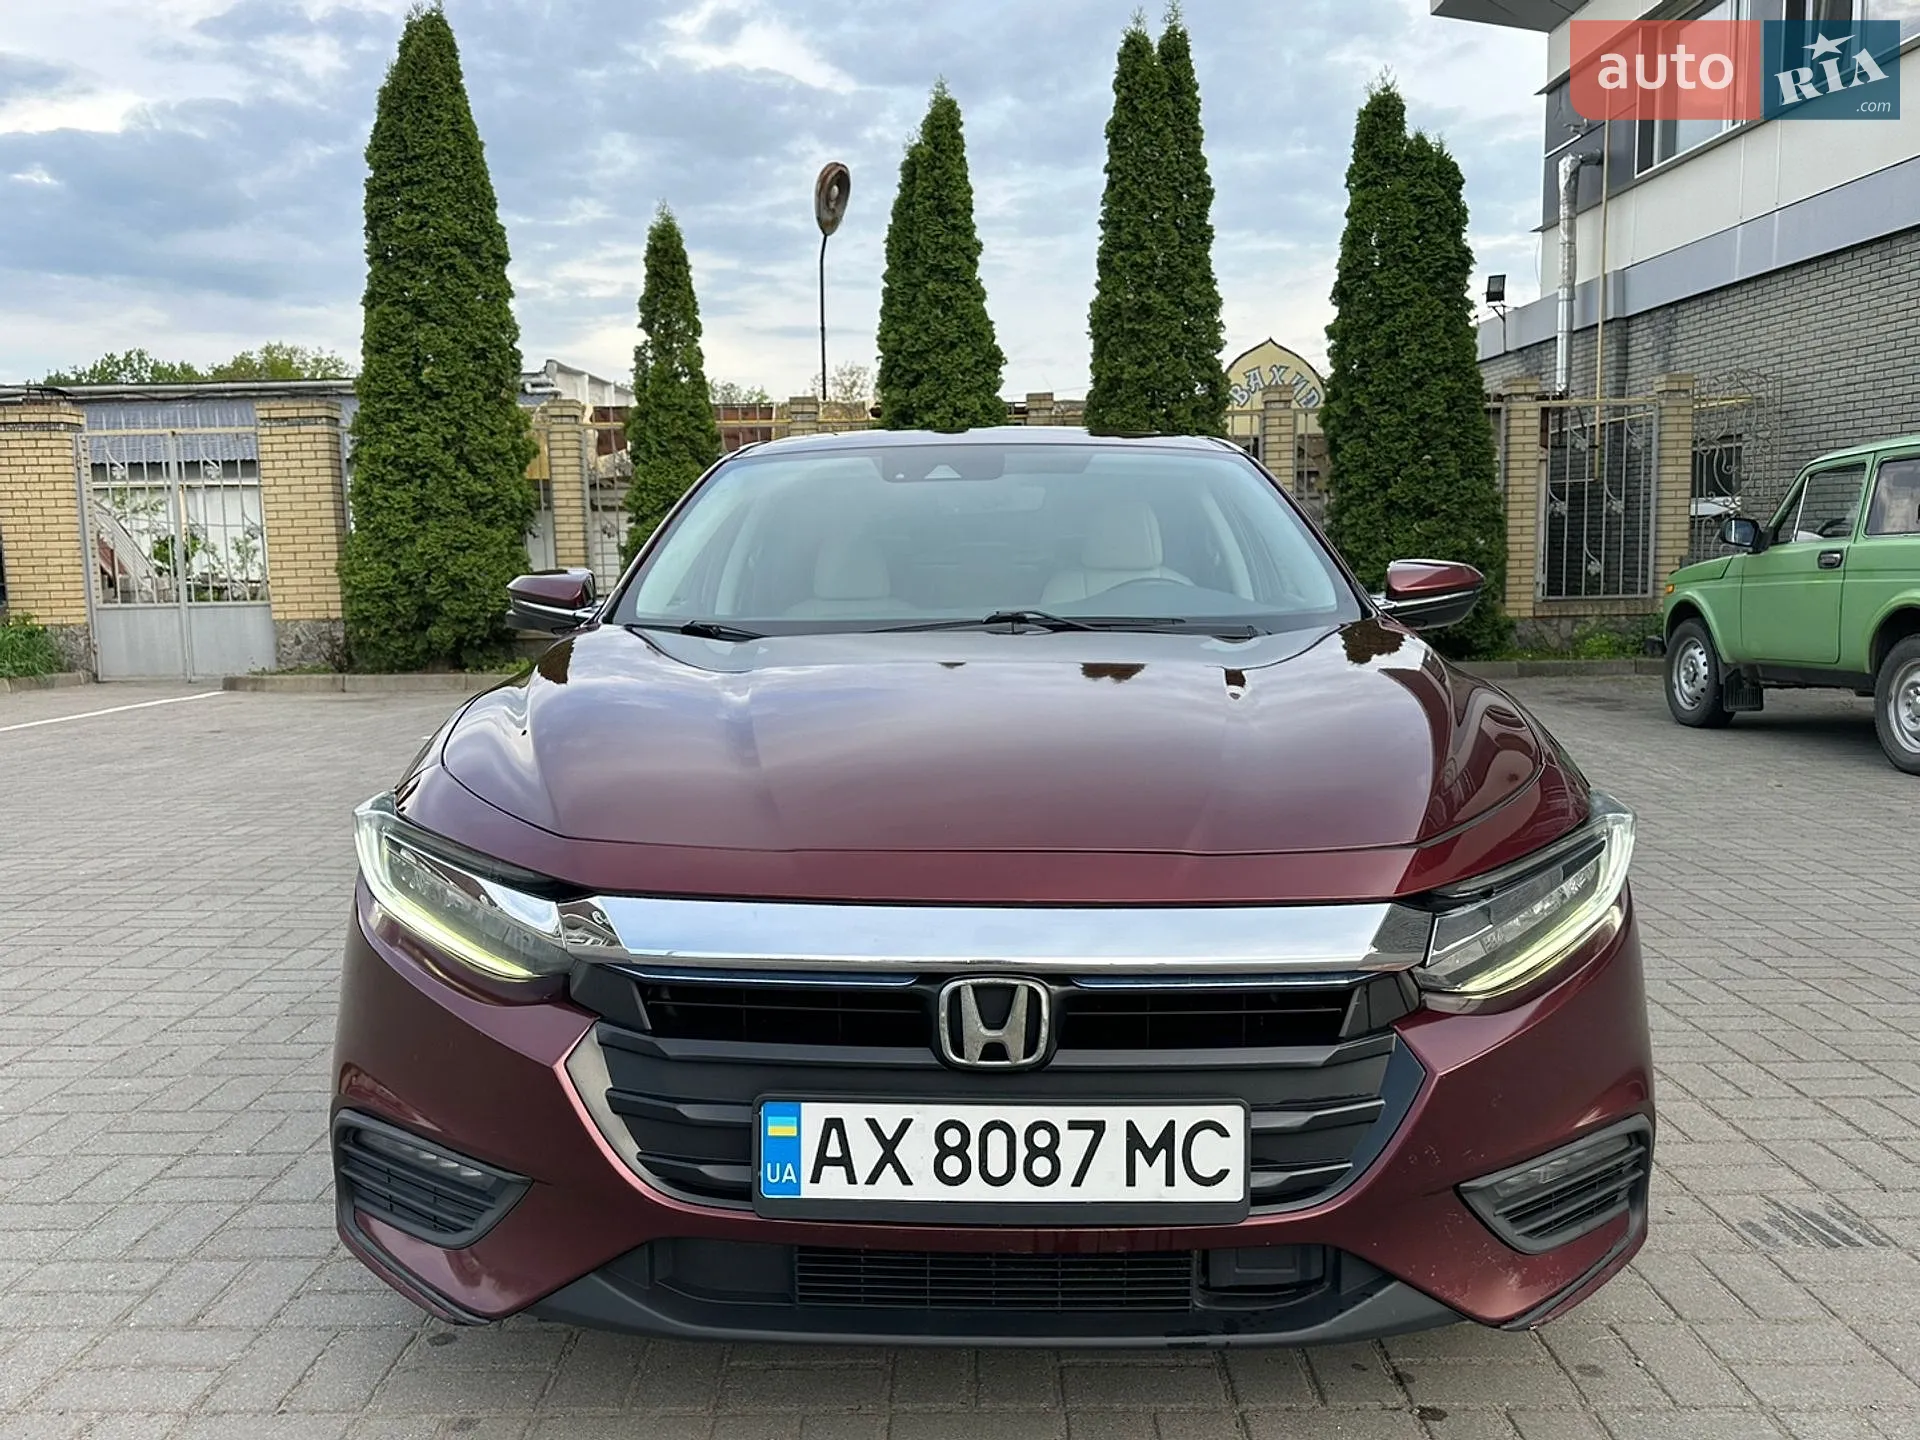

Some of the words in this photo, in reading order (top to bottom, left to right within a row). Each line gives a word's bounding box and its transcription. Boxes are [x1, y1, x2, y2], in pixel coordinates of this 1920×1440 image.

[766, 1162, 798, 1184] UA
[809, 1117, 914, 1186] AX
[932, 1118, 1107, 1188] 8087
[1125, 1119, 1231, 1188] MC
